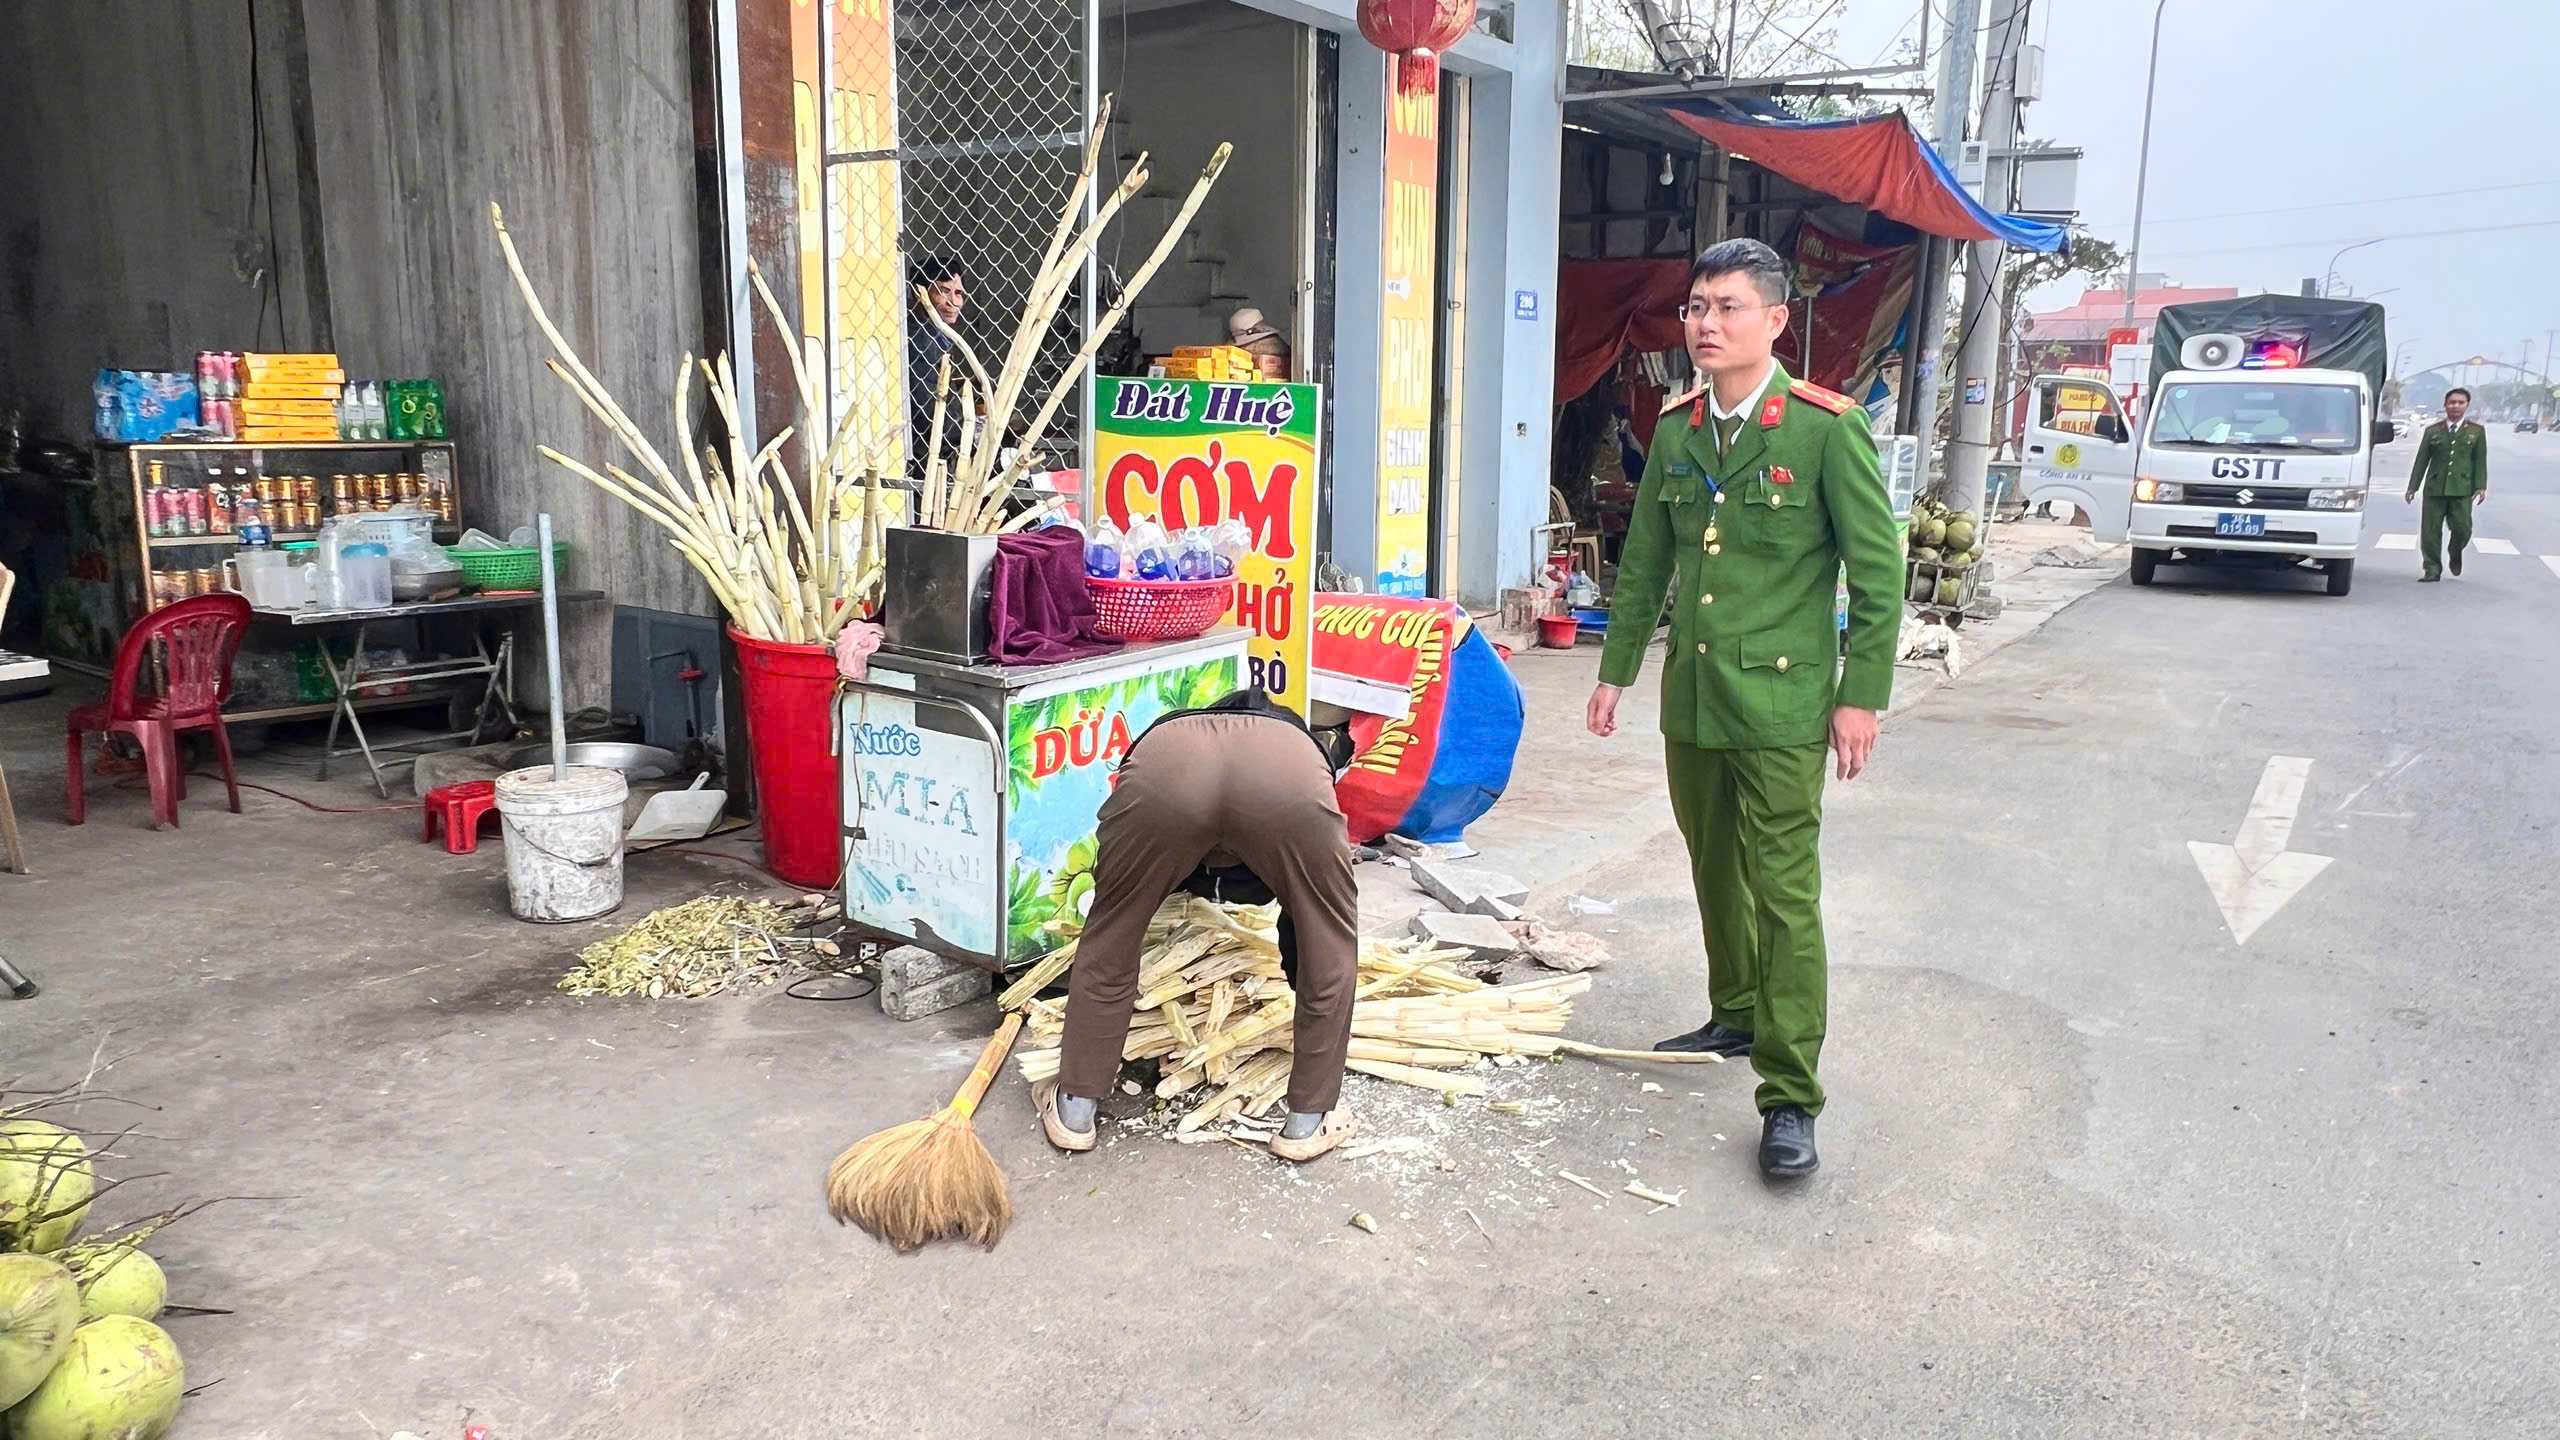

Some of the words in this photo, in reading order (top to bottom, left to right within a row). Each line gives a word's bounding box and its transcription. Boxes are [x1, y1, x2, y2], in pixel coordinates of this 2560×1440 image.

[1111, 381, 1192, 422] Đát
[1203, 386, 1295, 436] Huệ
[2212, 457, 2286, 480] CSTT
[1105, 440, 1297, 559] CƠM
[1222, 567, 1295, 641] HỞ
[1248, 651, 1286, 694] BÒ
[850, 723, 920, 756] Nước
[1032, 708, 1134, 779] DỪA
